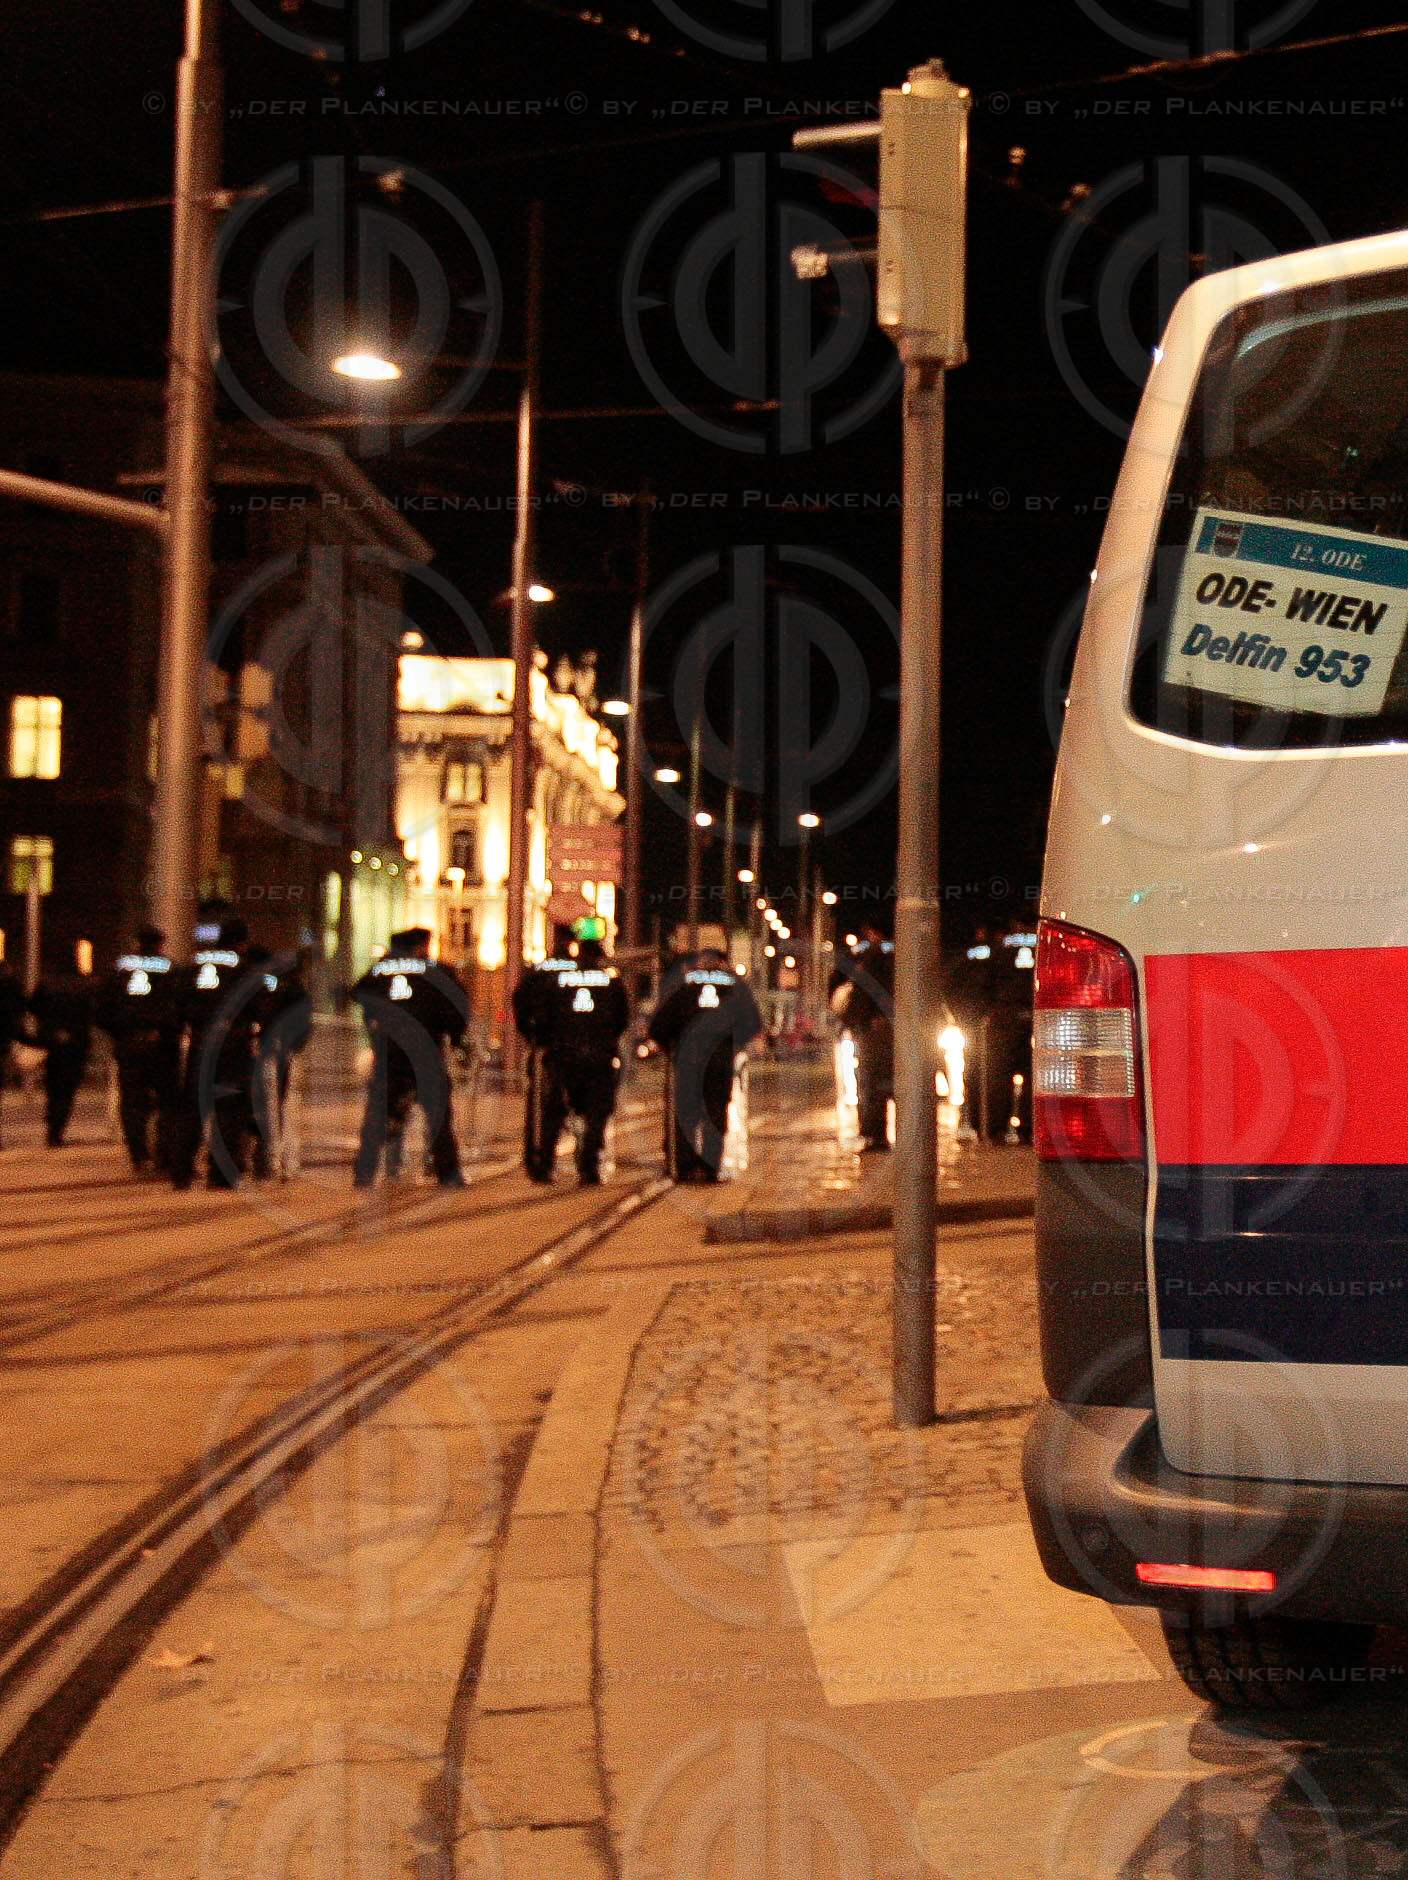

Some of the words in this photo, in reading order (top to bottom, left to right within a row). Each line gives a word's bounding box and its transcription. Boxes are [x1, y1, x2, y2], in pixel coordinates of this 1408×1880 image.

[1321, 549, 1369, 572] ODE
[1285, 586, 1388, 635] WIEN
[1180, 623, 1288, 673] Delfin
[1294, 644, 1371, 688] 953
